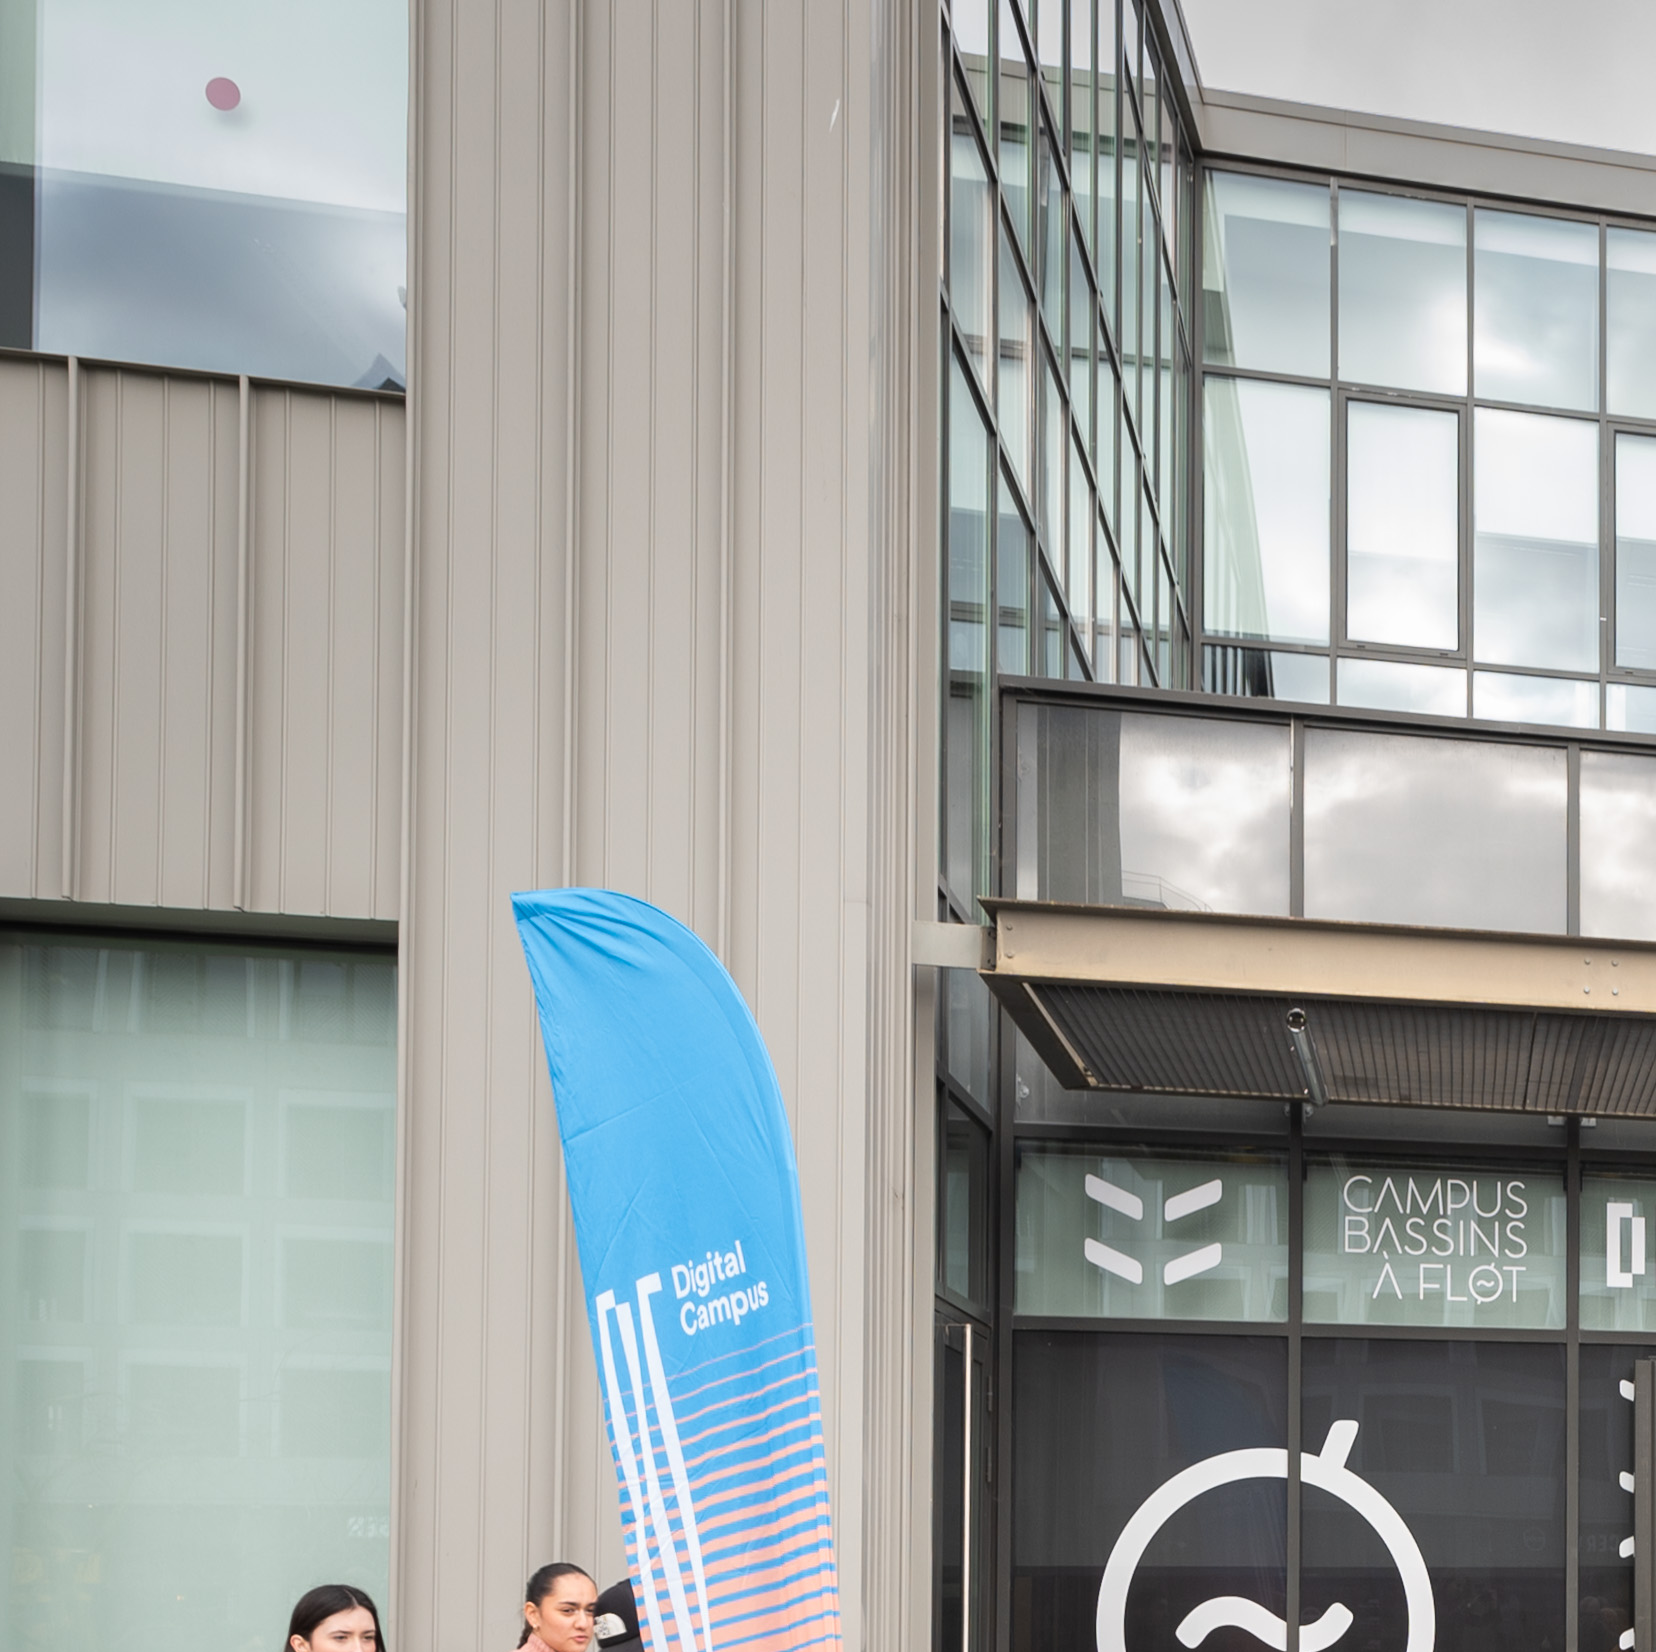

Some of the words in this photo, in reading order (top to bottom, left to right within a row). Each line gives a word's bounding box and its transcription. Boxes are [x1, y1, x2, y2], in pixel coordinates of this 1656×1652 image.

[1343, 1175, 1528, 1219] CAMPUS
[1344, 1216, 1528, 1259] BASSINS
[670, 1239, 747, 1300] Digital
[679, 1281, 770, 1337] Campus
